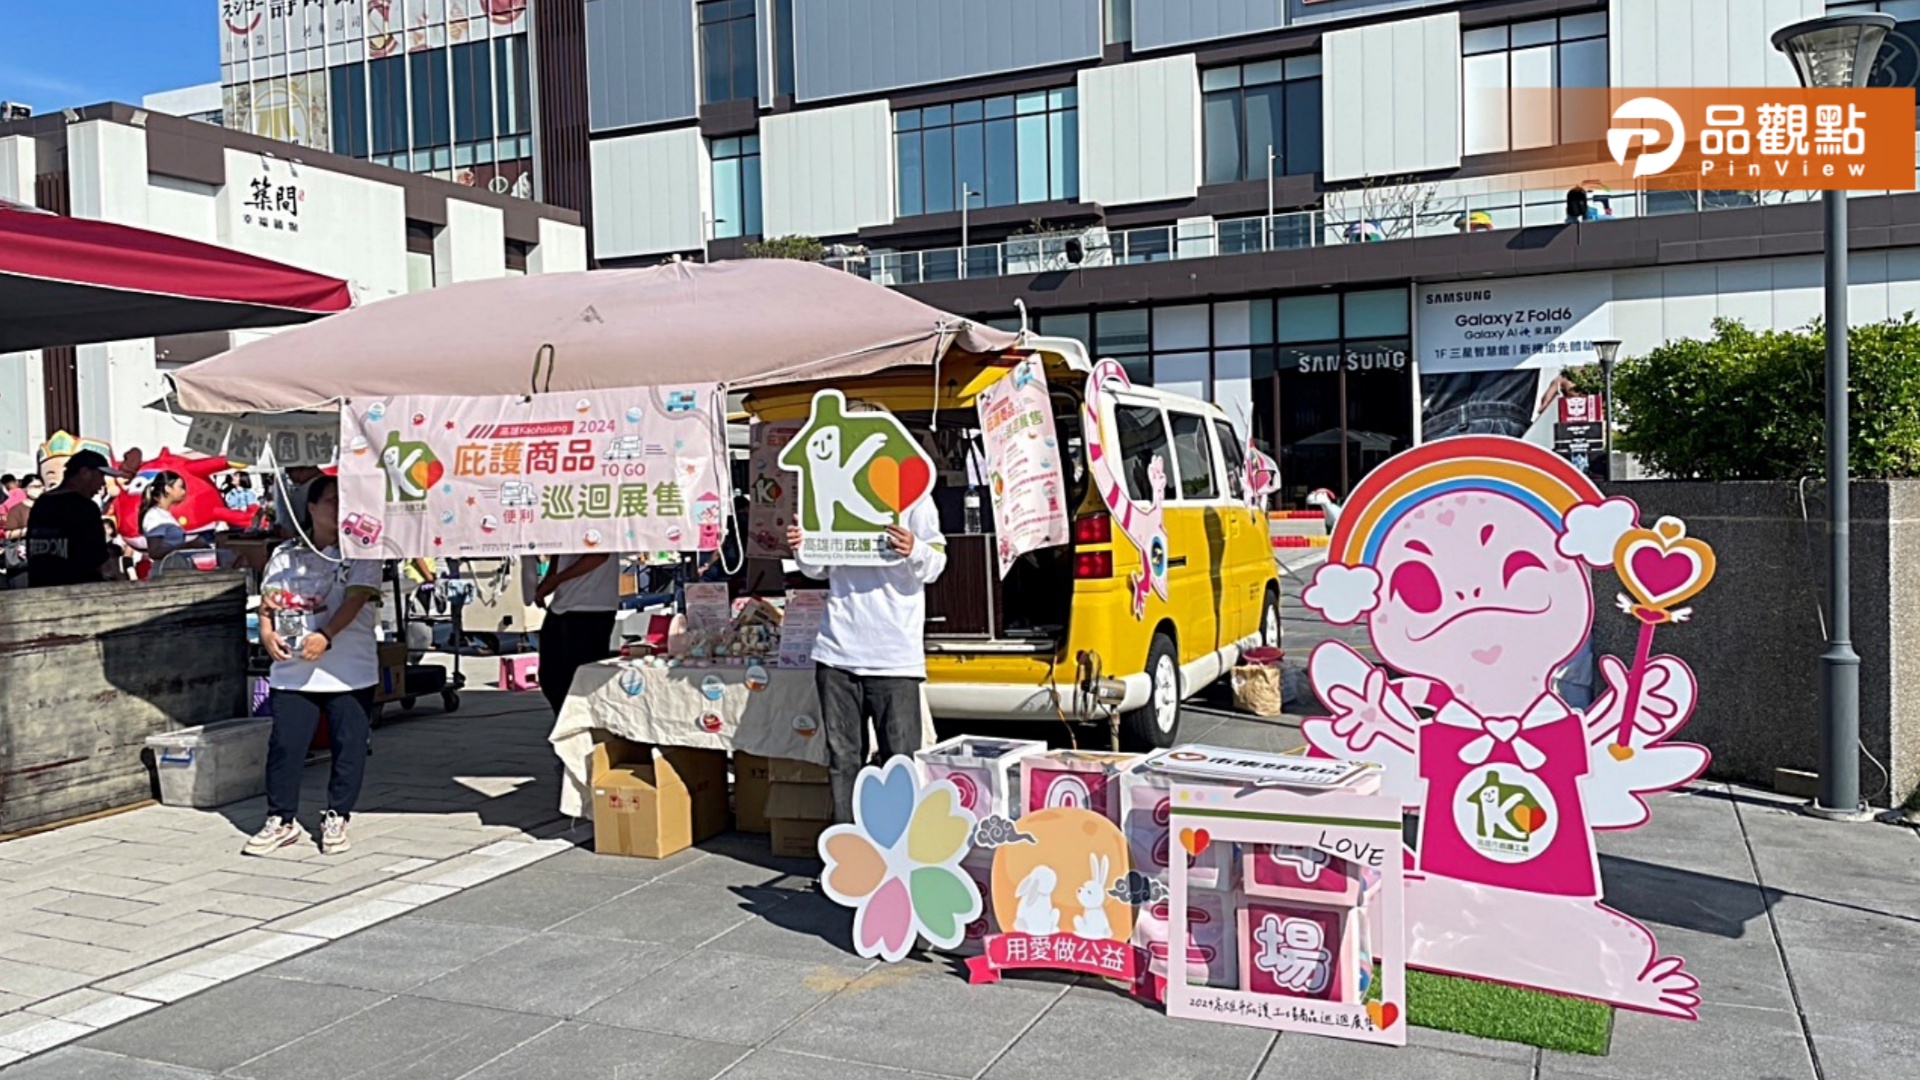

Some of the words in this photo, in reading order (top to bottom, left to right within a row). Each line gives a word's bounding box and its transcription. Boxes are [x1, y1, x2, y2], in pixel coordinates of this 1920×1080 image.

[1426, 290, 1491, 304] SAMSUNG
[1455, 313, 1513, 327] Galaxy
[1515, 311, 1524, 323] Z
[1528, 308, 1572, 322] Fold6
[1464, 330, 1505, 340] Galaxy
[1299, 351, 1405, 373] SAMSUNG
[578, 420, 616, 433] 2024
[454, 439, 595, 476] 庇護商品
[602, 464, 619, 476] TO
[623, 463, 646, 476] GO
[541, 481, 684, 520] 巡迴展售
[503, 509, 534, 524] 便利
[804, 537, 893, 552] 高雄市庇護工
[1318, 830, 1385, 866] LOVE
[1005, 937, 1126, 972] 用愛做公益
